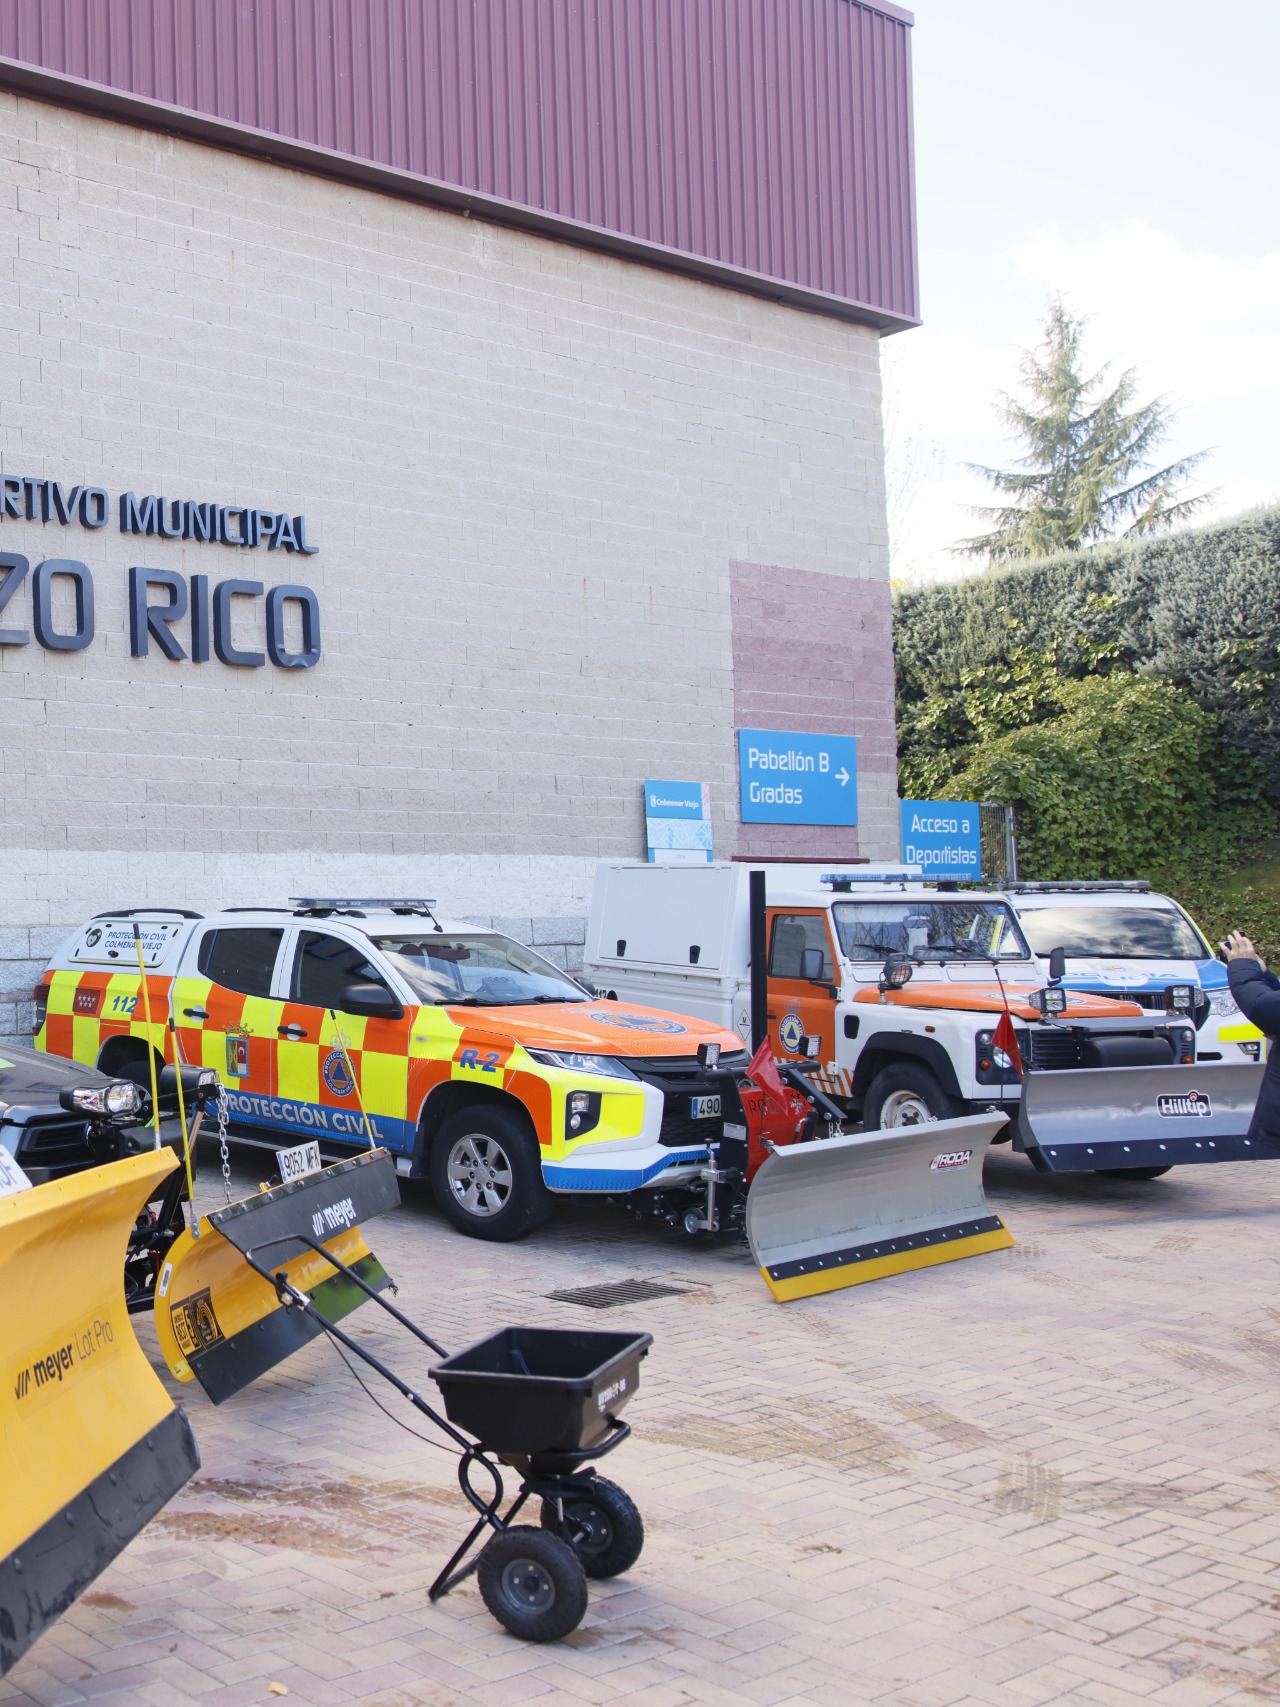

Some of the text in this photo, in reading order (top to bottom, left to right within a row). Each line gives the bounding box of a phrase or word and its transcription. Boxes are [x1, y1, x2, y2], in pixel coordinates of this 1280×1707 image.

[120, 491, 320, 556] MUNICIPAL
[128, 566, 322, 669] RICO
[748, 748, 830, 773] Pabellón B
[657, 798, 699, 809] Colmenar Viejo
[749, 781, 803, 806] Gradas
[910, 813, 971, 834] Acceso a
[905, 845, 977, 867] Deportistas
[104, 940, 162, 950] COLMENA VIEJO
[107, 930, 167, 941] PROTECCÓN CIVIL
[112, 995, 139, 1014] 112
[459, 1048, 501, 1073] R-2
[220, 1092, 385, 1139] ROTECCIÓN CIVL
[699, 1098, 720, 1115] 490
[1161, 1098, 1208, 1117] Hilltip
[283, 1151, 305, 1177] 9052
[939, 1151, 971, 1165] RODA
[323, 1197, 357, 1229] meyer
[33, 1319, 114, 1388] meyer Lot Pro
